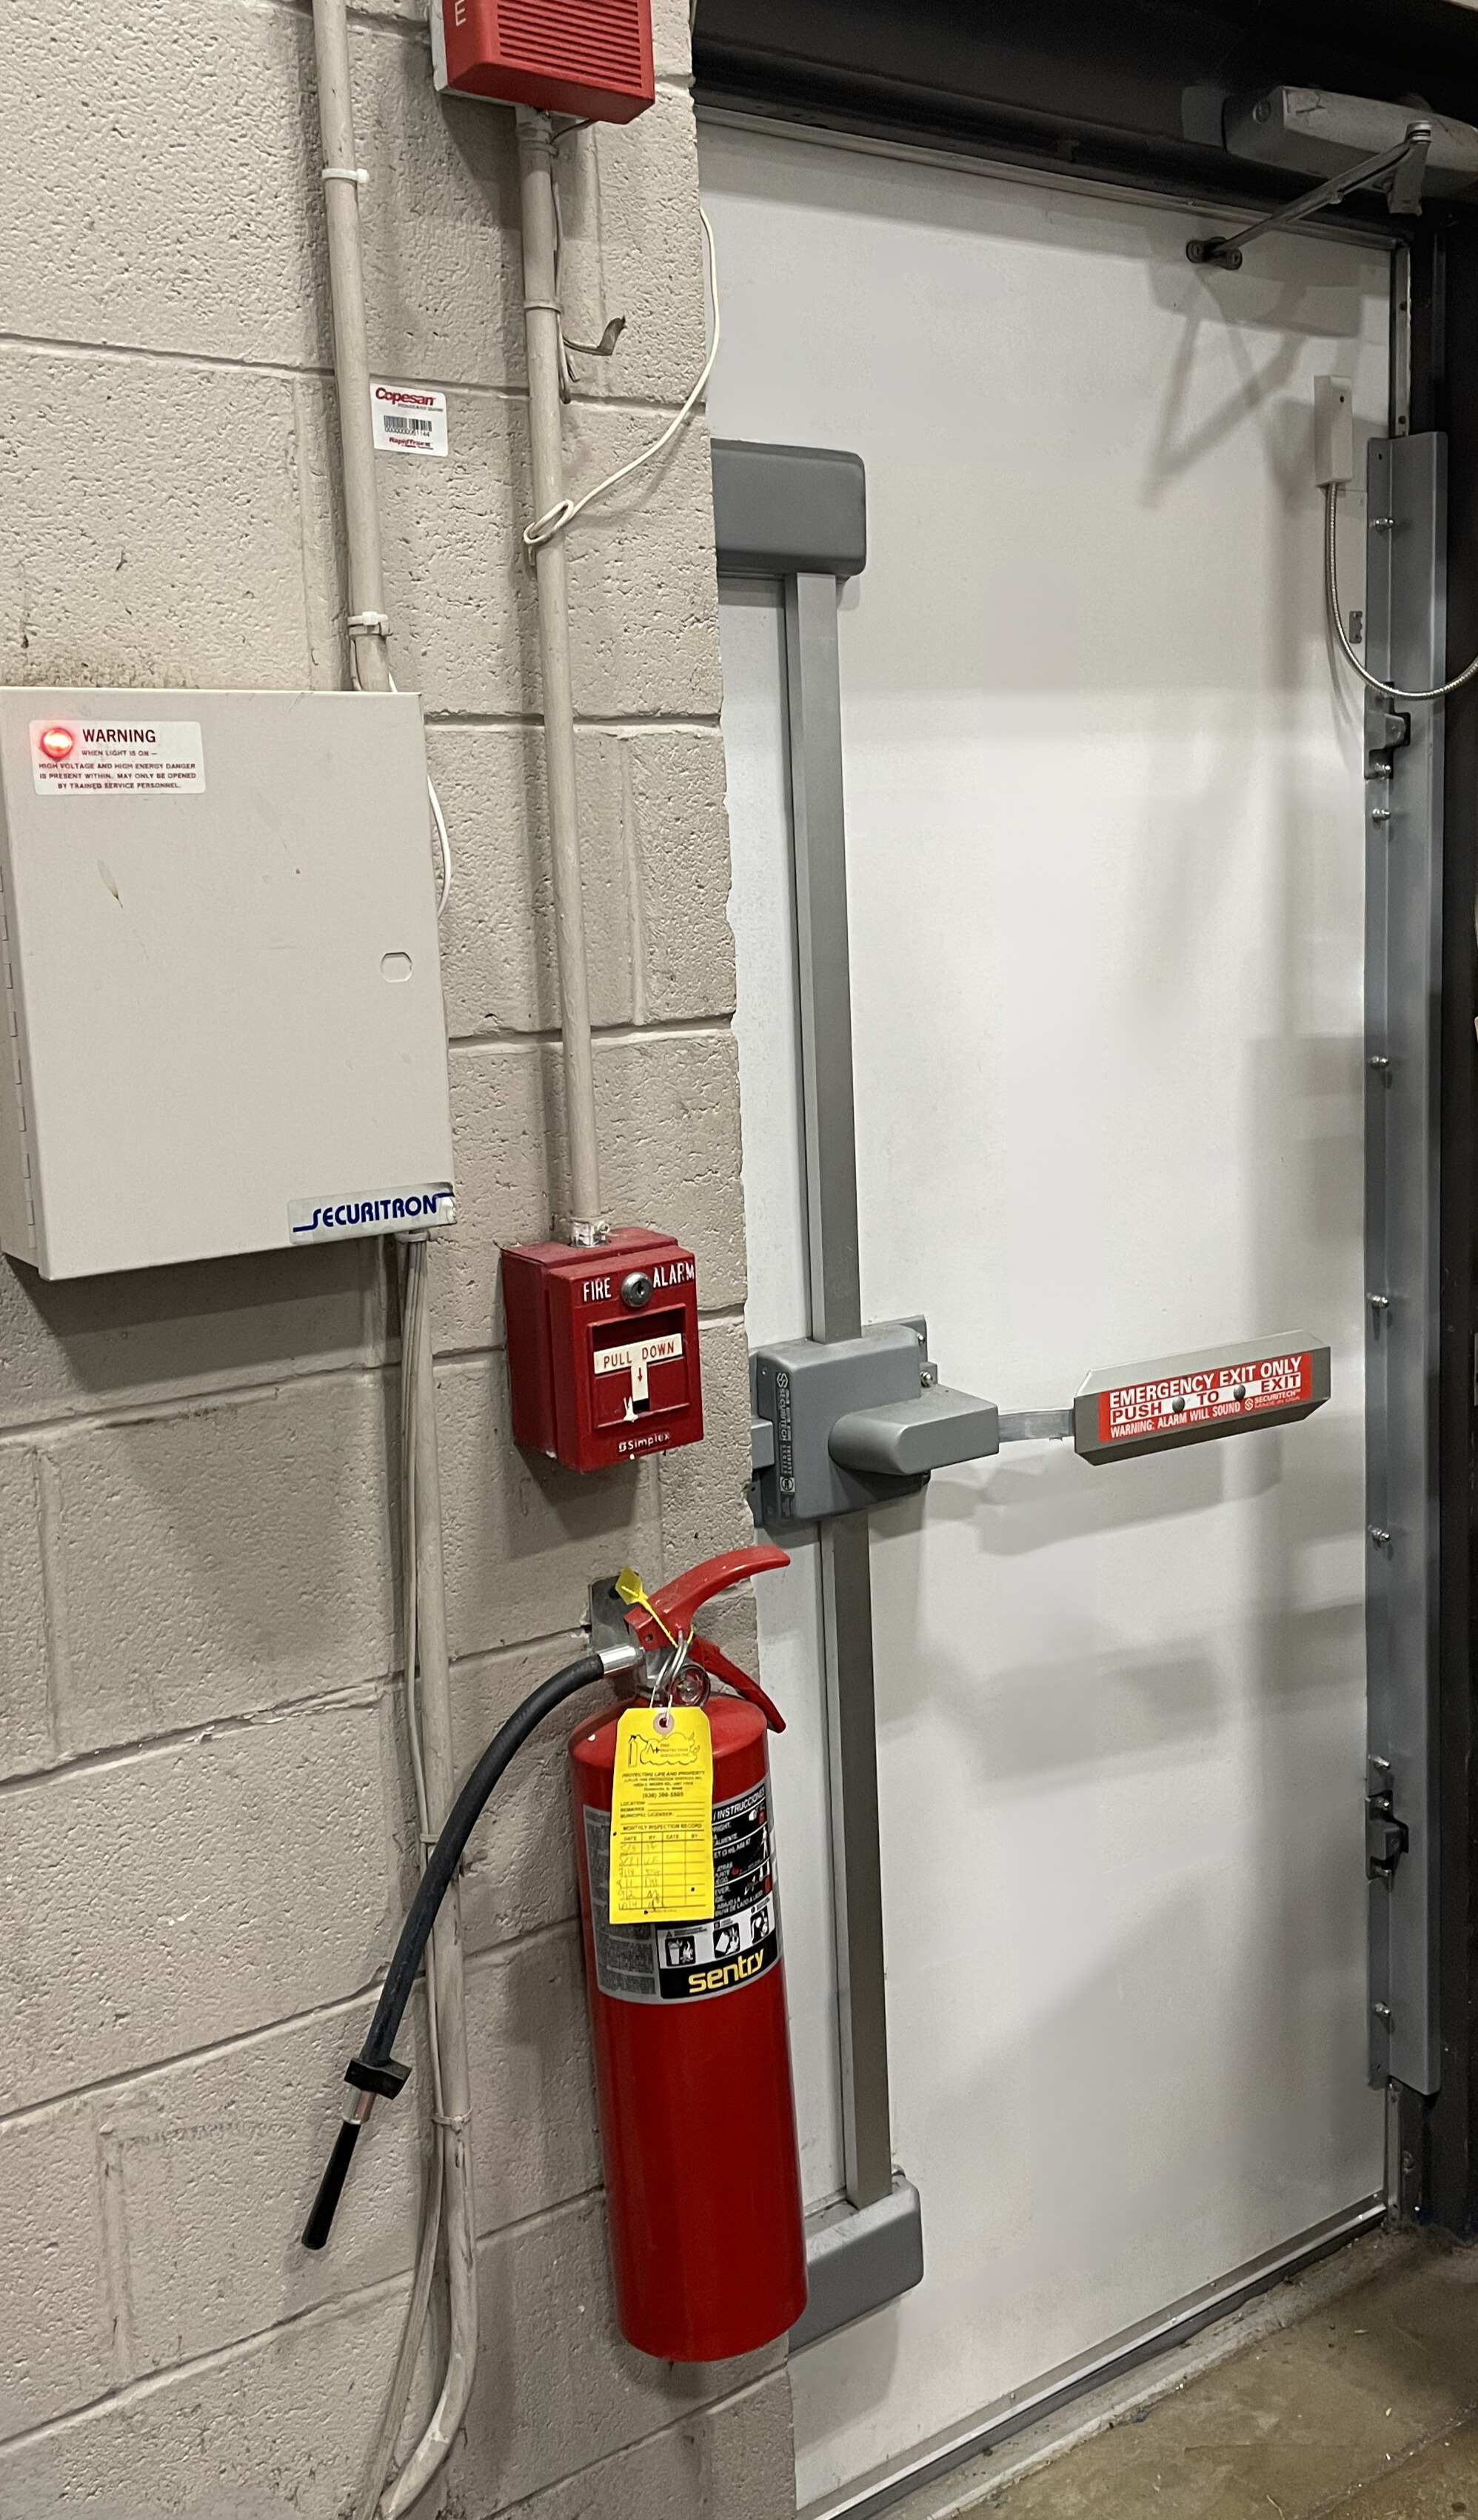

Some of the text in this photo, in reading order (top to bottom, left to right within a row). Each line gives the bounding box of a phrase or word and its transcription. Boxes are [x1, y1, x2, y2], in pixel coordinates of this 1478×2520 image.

[375, 387, 434, 406] Copesan
[82, 729, 156, 743] WARNING
[293, 1192, 455, 1233] SECURITRON
[583, 1261, 695, 1302] FIRE ALARM
[603, 1341, 674, 1368] PULL DOWN
[1110, 1356, 1302, 1408] EMERGENCY EXIT ONLY
[1112, 1374, 1300, 1423] PUSH TO EXIT
[1111, 1401, 1240, 1438] WARNING: ALARM WILL SOUND
[627, 1431, 670, 1450] Simplex
[689, 1949, 763, 1993] sentry
